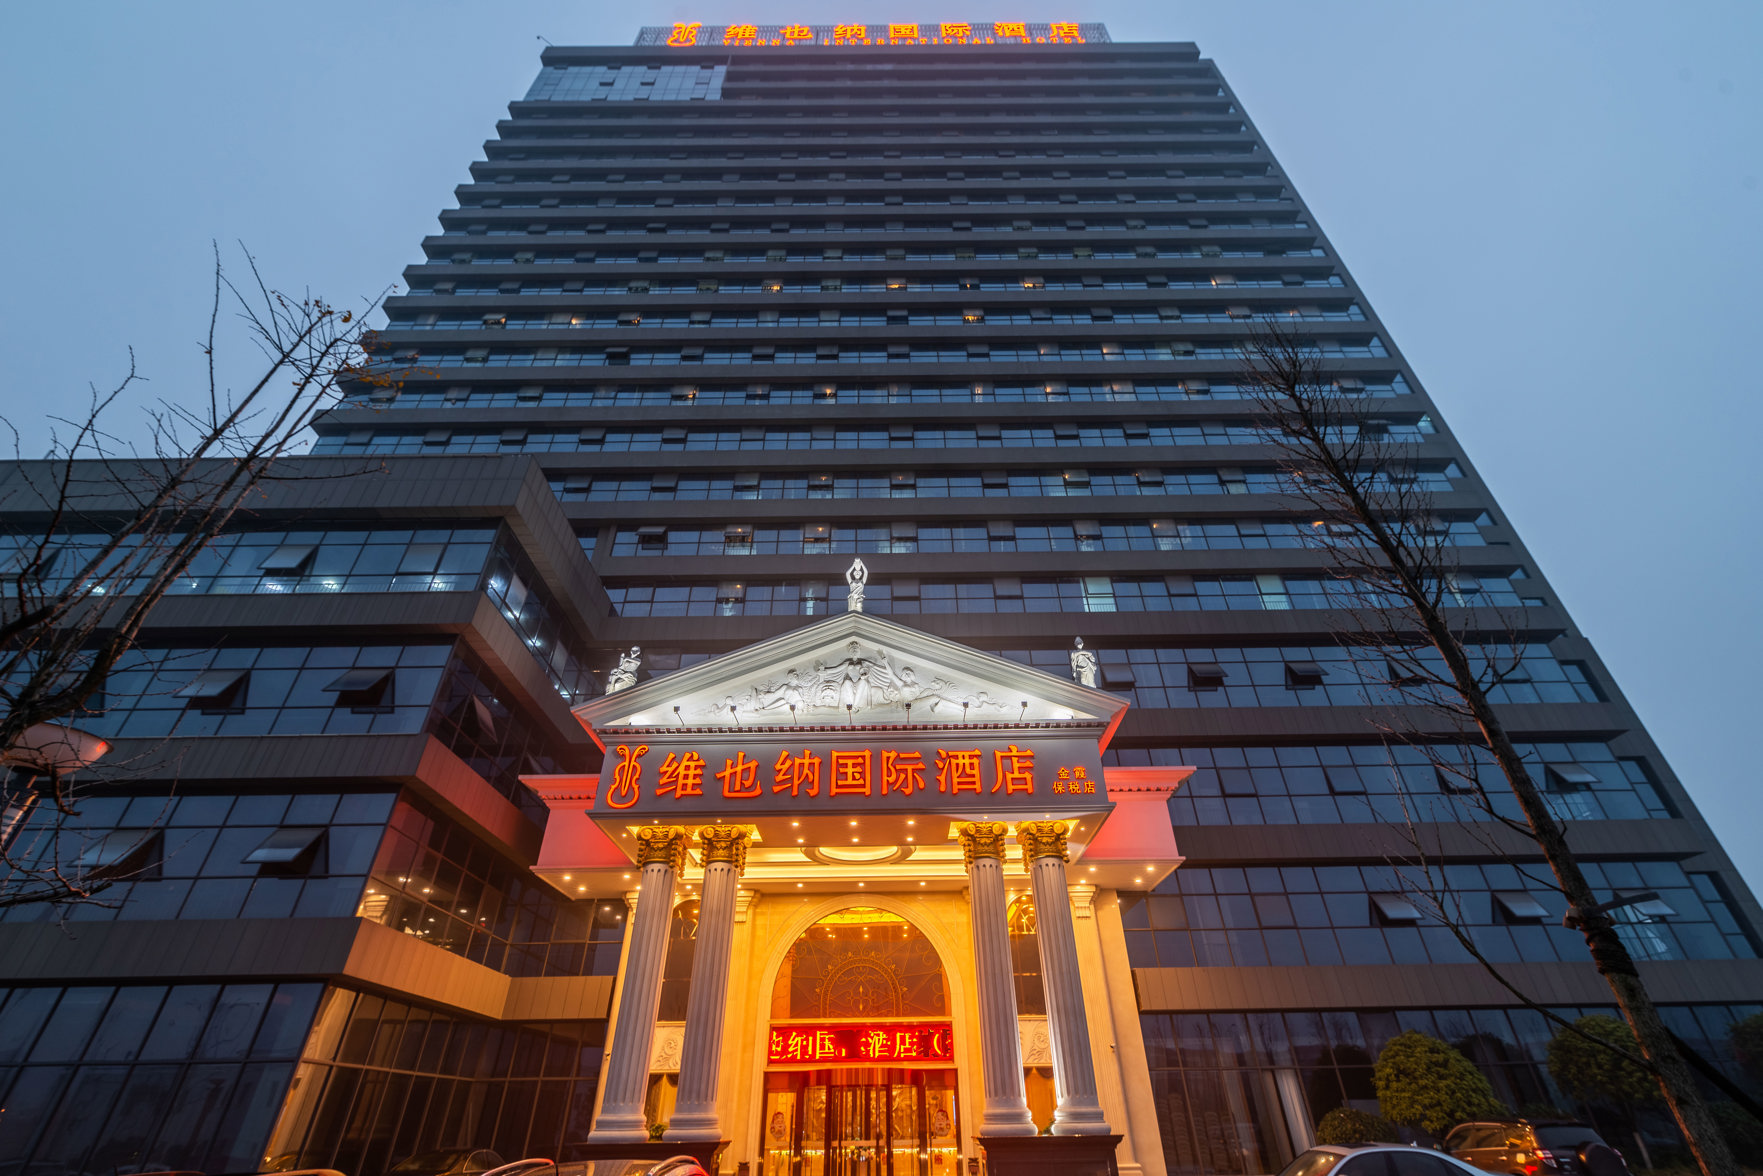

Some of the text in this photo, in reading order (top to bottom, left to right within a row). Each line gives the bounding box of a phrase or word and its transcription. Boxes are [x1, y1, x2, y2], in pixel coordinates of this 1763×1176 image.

[724, 22, 1080, 39] 维也纳国际酒店
[823, 37, 995, 45] INTERNATIONAL
[656, 744, 1035, 799] 维也纳国际酒店
[1052, 780, 1096, 794] 保税店
